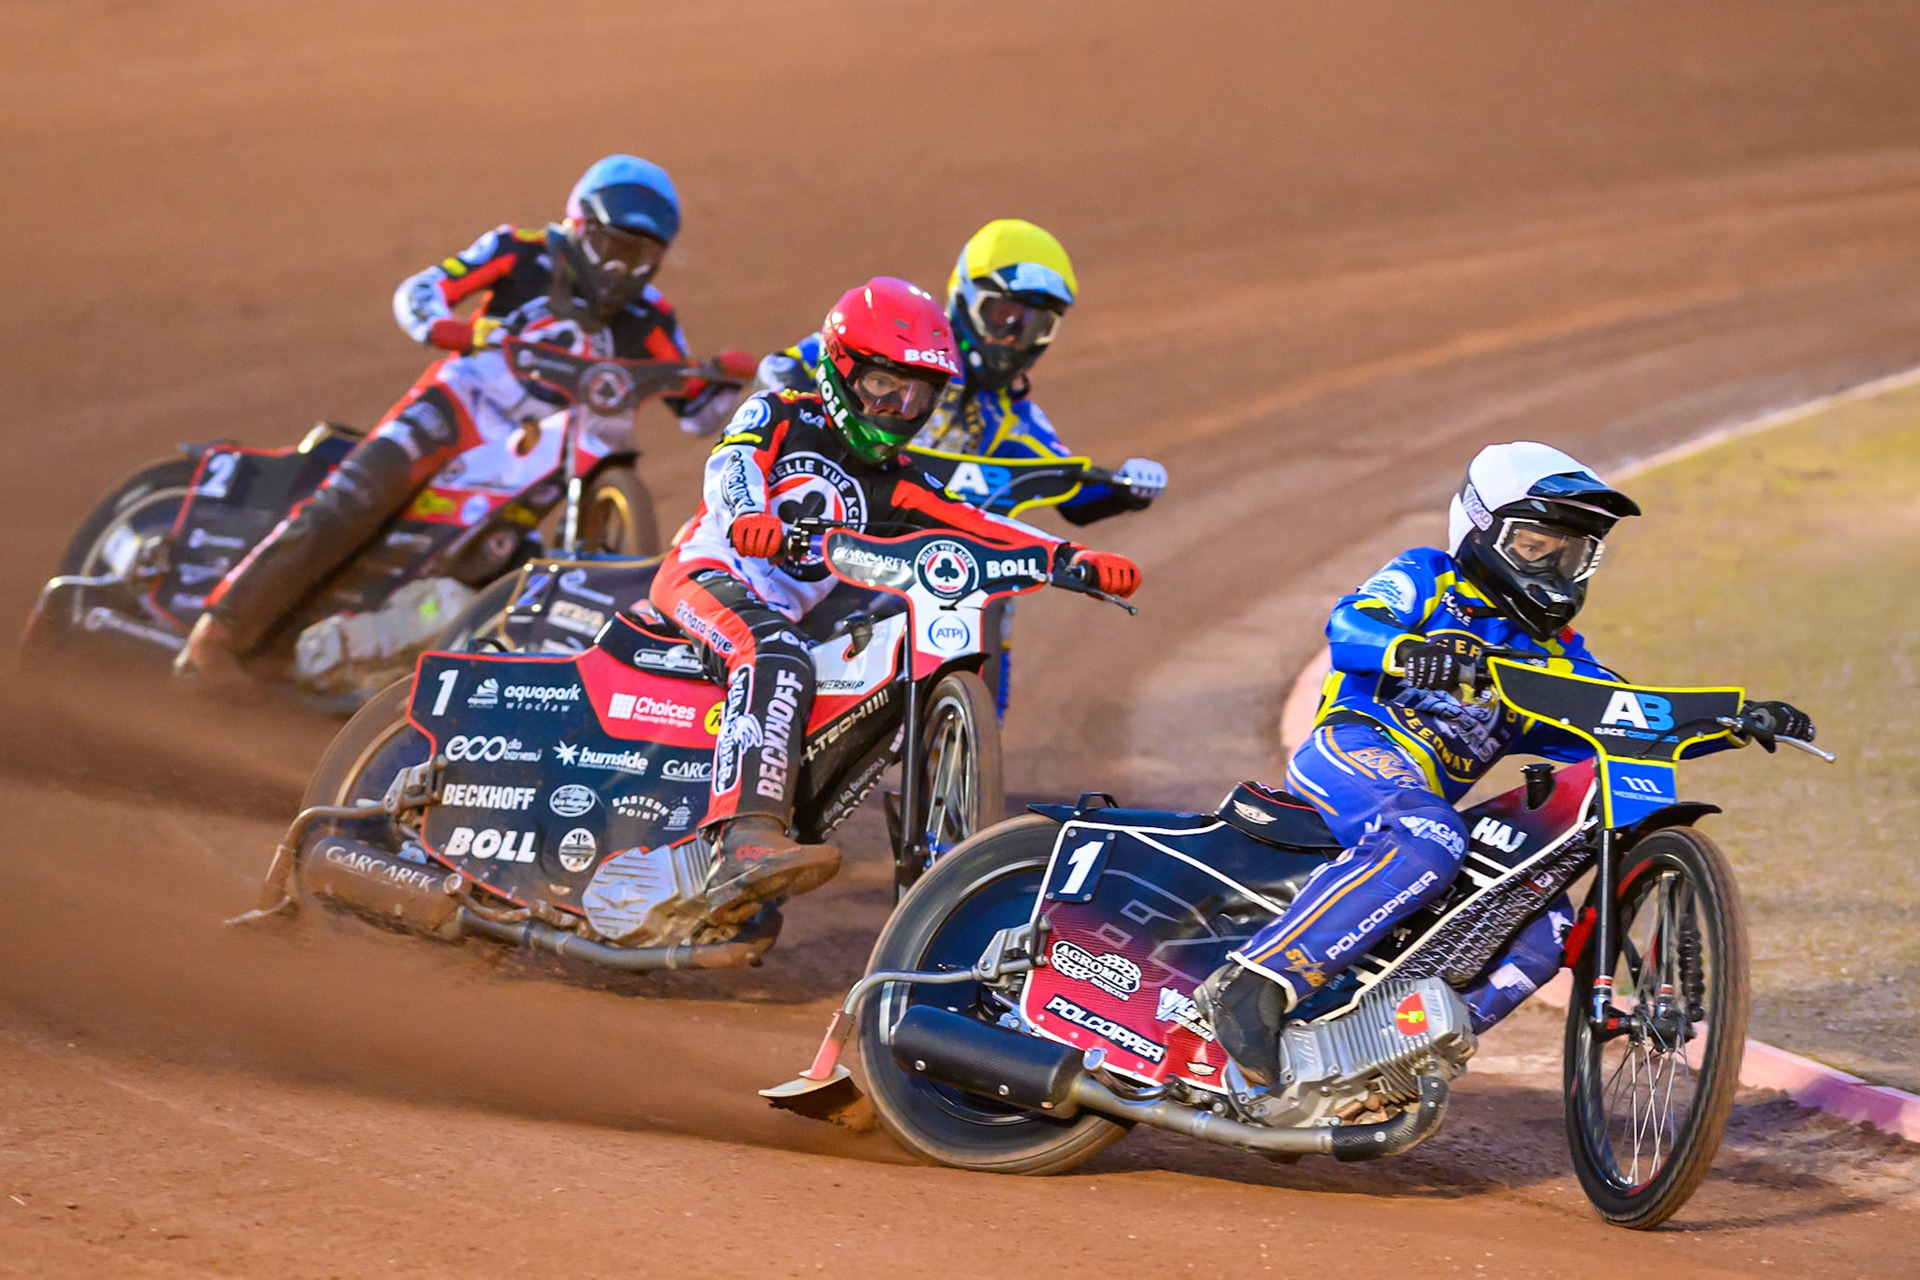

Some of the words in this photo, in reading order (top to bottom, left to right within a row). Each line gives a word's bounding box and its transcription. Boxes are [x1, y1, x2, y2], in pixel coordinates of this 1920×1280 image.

[904, 349, 959, 373] BOLL
[201, 453, 237, 498] 2
[822, 464, 851, 492] VUE
[947, 462, 1013, 496] AB
[986, 558, 1040, 579] BOLL
[431, 669, 459, 716] 1
[504, 683, 581, 703] aquapark
[635, 696, 696, 721] Choices
[1600, 690, 1675, 732] AB
[445, 735, 507, 762] eco
[756, 669, 804, 802] BECKHOFF
[578, 746, 649, 770] burnside
[441, 783, 537, 811] BECKHOFF
[612, 795, 669, 816] EASTERN
[617, 807, 660, 822] POINT
[444, 827, 537, 863] BOLL
[1058, 840, 1105, 895] 1
[1325, 870, 1439, 960] POLCOPPER
[1057, 944, 1133, 990] AGROMIX
[1045, 996, 1165, 1063] POLCOPPER
